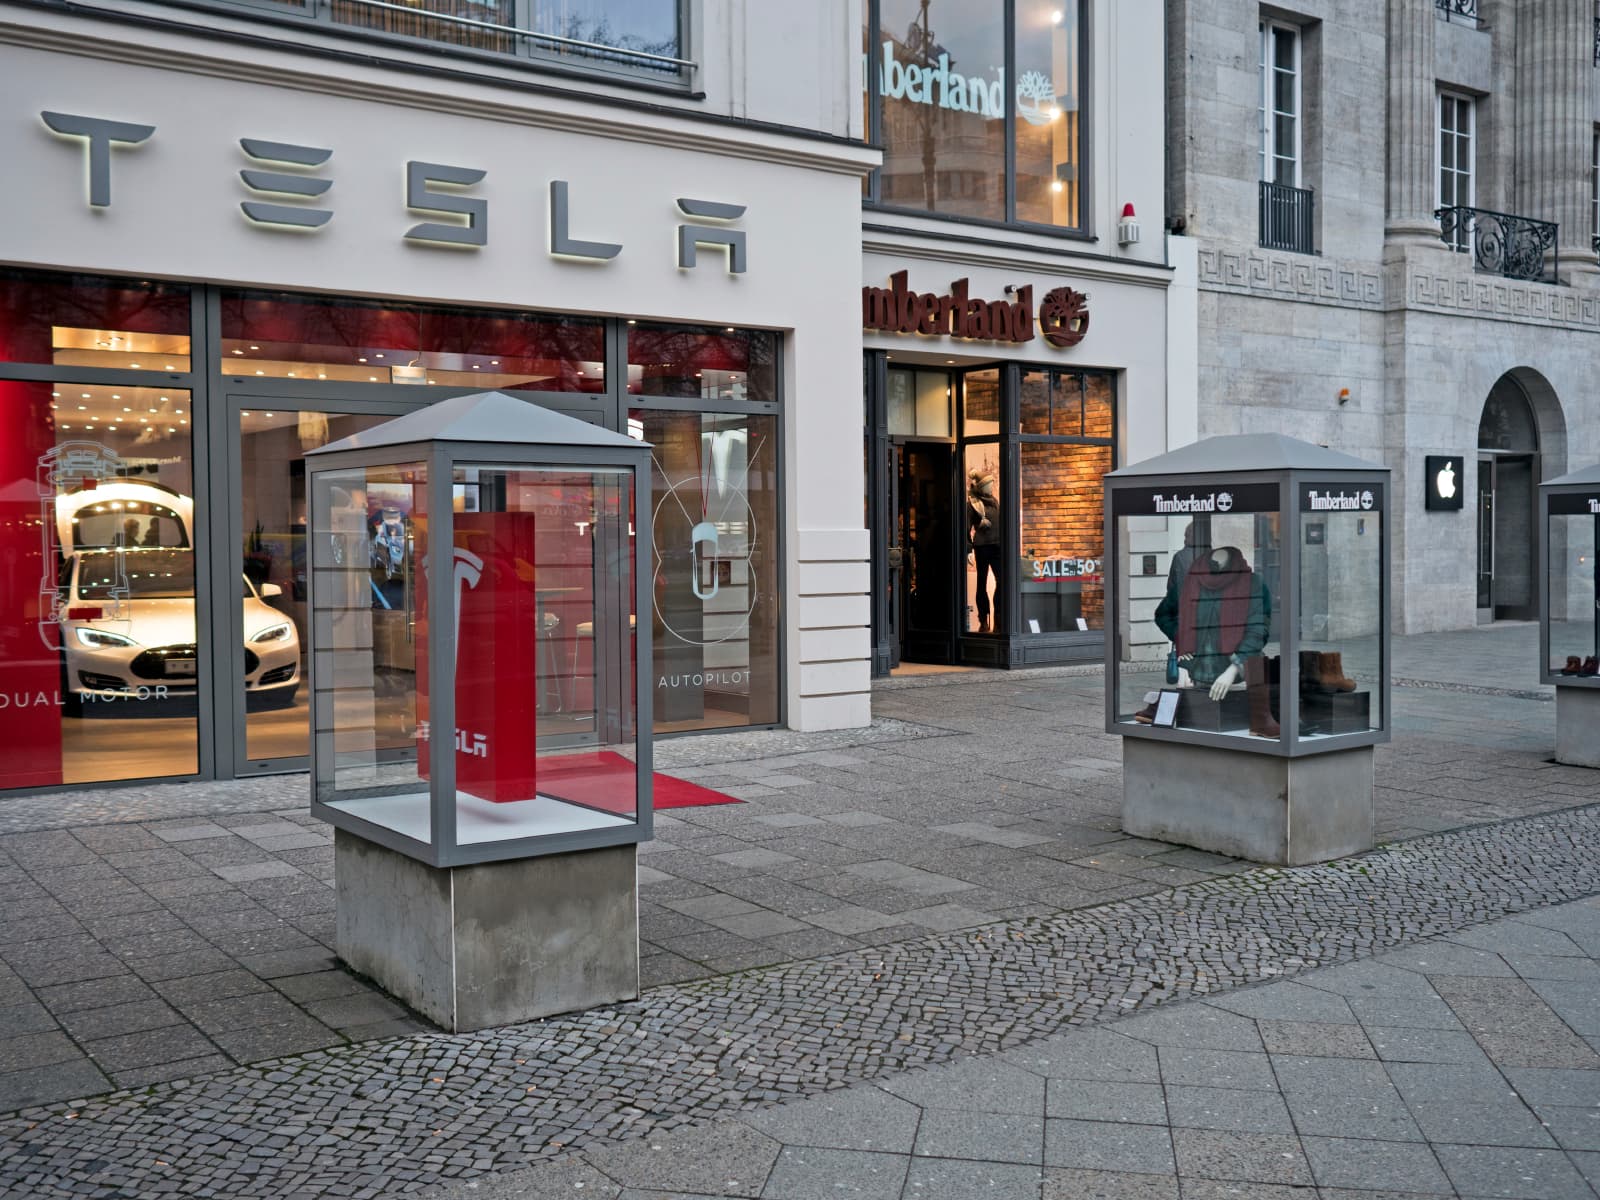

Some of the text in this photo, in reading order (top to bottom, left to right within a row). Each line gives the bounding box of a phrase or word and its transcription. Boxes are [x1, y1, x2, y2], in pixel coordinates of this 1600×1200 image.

[863, 40, 1005, 119] berland
[41, 110, 747, 275] TESLA
[1153, 493, 1215, 512] Timberland
[1308, 490, 1360, 510] Timberland
[1033, 560, 1069, 576] SALE
[658, 671, 751, 688] AUTOPILOT
[0, 685, 168, 709] DUAL MOTOR
